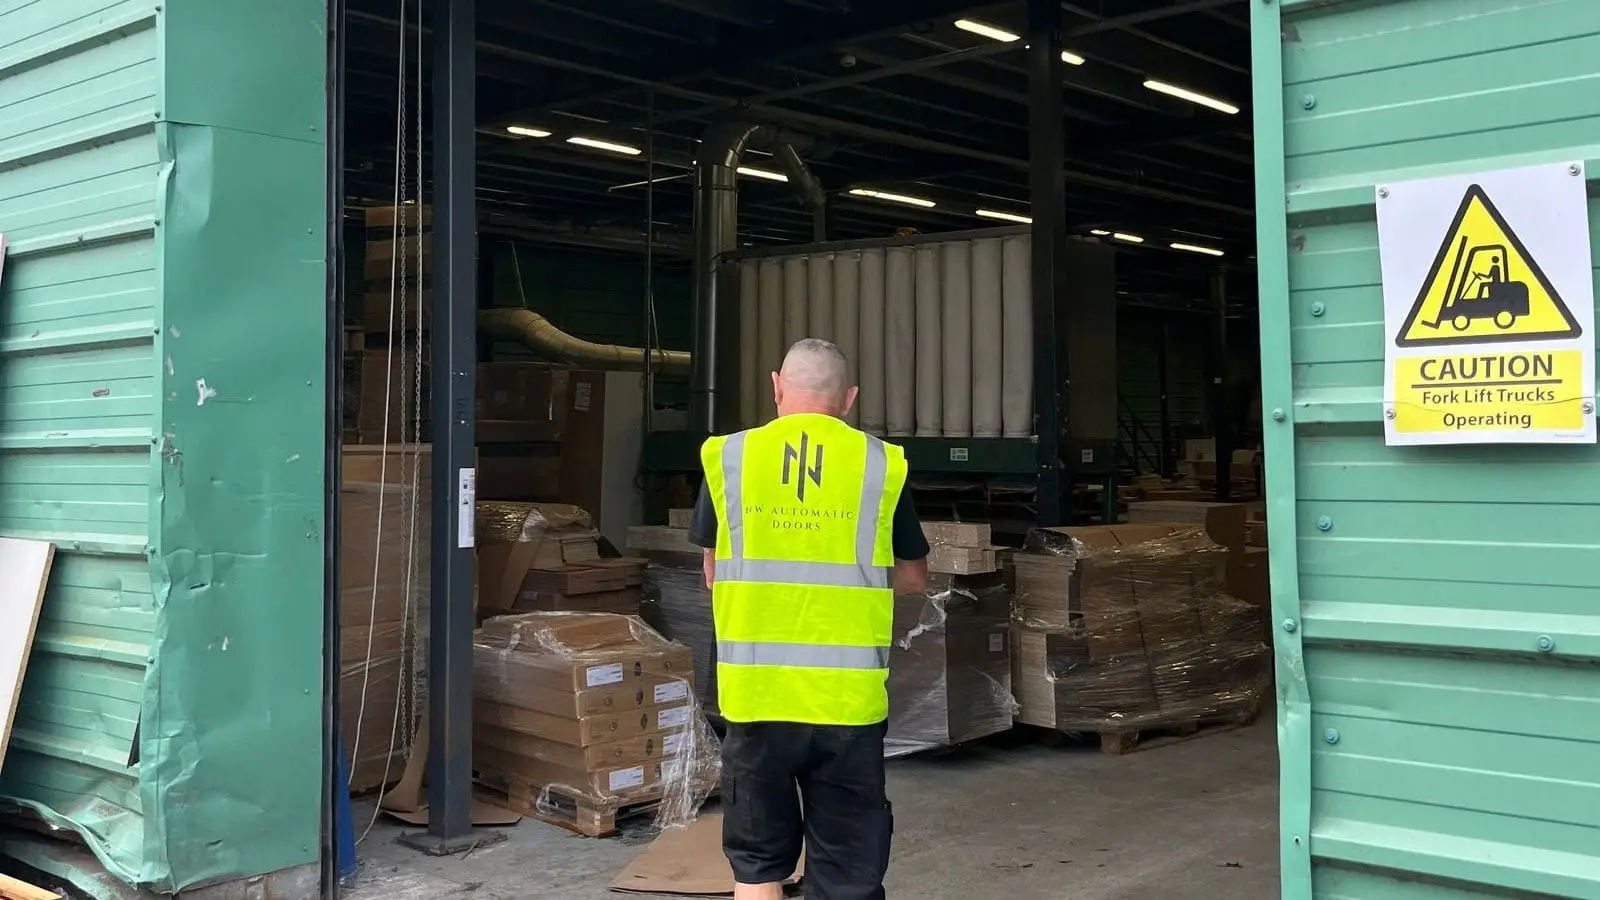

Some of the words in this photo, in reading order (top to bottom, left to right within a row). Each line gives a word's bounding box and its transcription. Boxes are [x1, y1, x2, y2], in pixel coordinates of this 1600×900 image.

[1420, 354, 1553, 381] CAUTION
[1423, 390, 1459, 404] Fork
[1464, 388, 1493, 403] Lift
[1497, 387, 1555, 402] Trucks
[1443, 411, 1532, 429] Operating
[745, 505, 763, 514] NW
[771, 506, 854, 520] AUTOMATIC
[772, 519, 820, 531] DOORS
